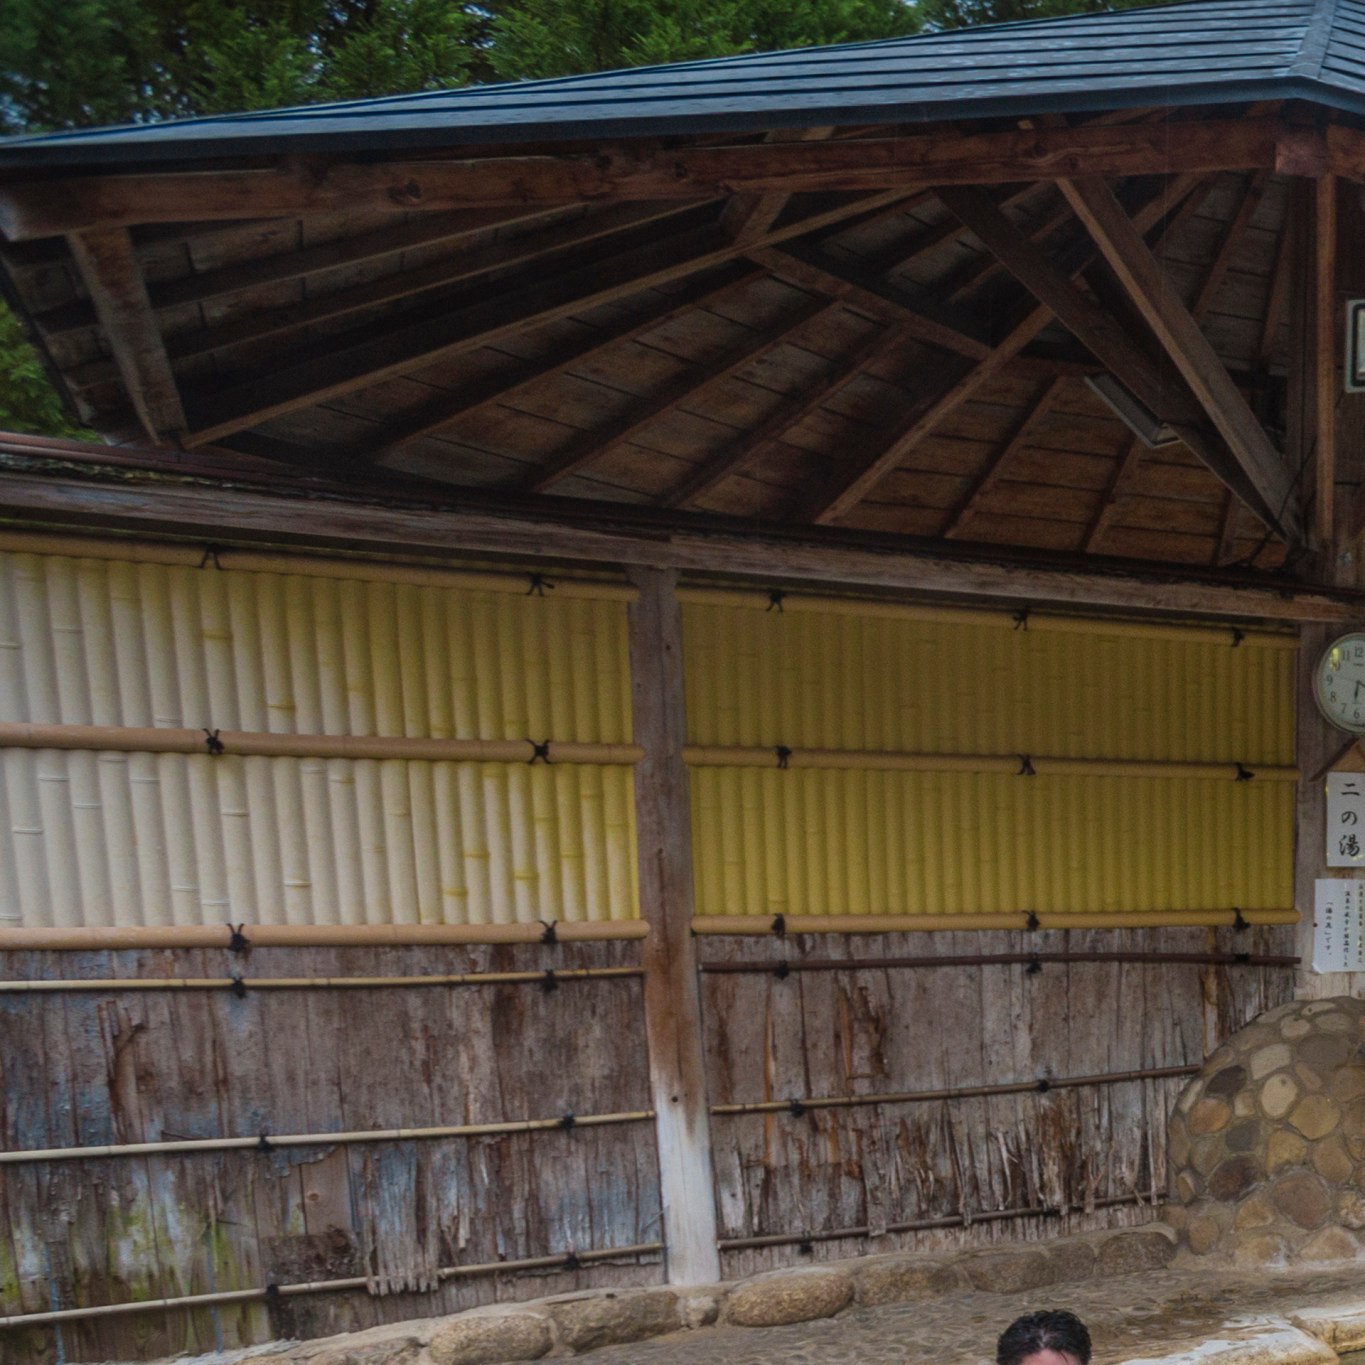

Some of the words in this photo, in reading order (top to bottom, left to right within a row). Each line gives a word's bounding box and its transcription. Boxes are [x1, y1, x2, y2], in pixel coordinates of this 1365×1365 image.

[1343, 650, 1349, 661] 11
[1355, 647, 1363, 658] 12
[1327, 675, 1333, 686] 9
[1330, 691, 1337, 703] 8
[1341, 703, 1347, 713] 7
[1354, 708, 1360, 719] 6
[1340, 783, 1360, 856] 二の湯
